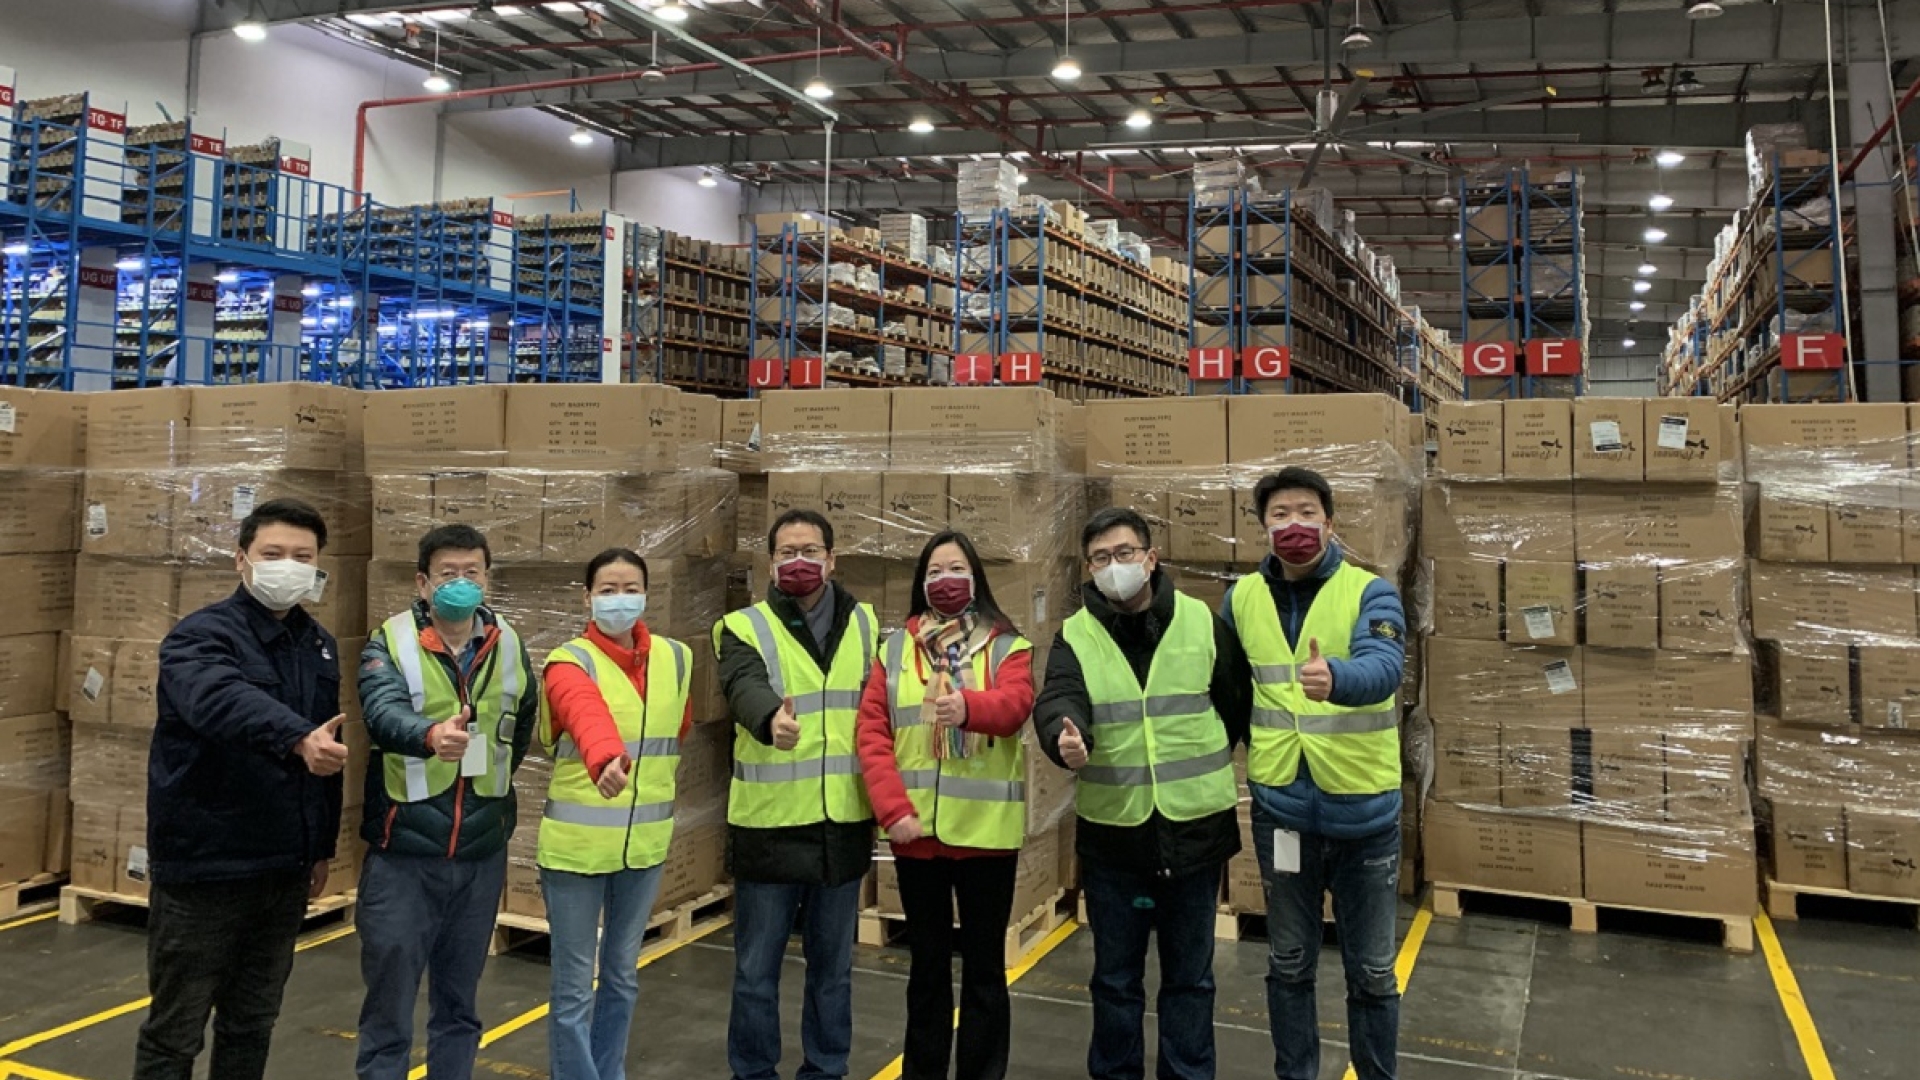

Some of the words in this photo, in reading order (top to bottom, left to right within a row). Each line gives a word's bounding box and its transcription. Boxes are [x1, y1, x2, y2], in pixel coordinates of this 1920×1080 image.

[1199, 349, 1224, 378] H
[1254, 347, 1283, 378] G
[1472, 343, 1508, 375] G
[1541, 342, 1564, 372] F
[1797, 335, 1826, 367] F
[757, 360, 771, 385] J
[803, 360, 813, 384] I
[968, 355, 978, 381] I
[1011, 354, 1031, 381] H
